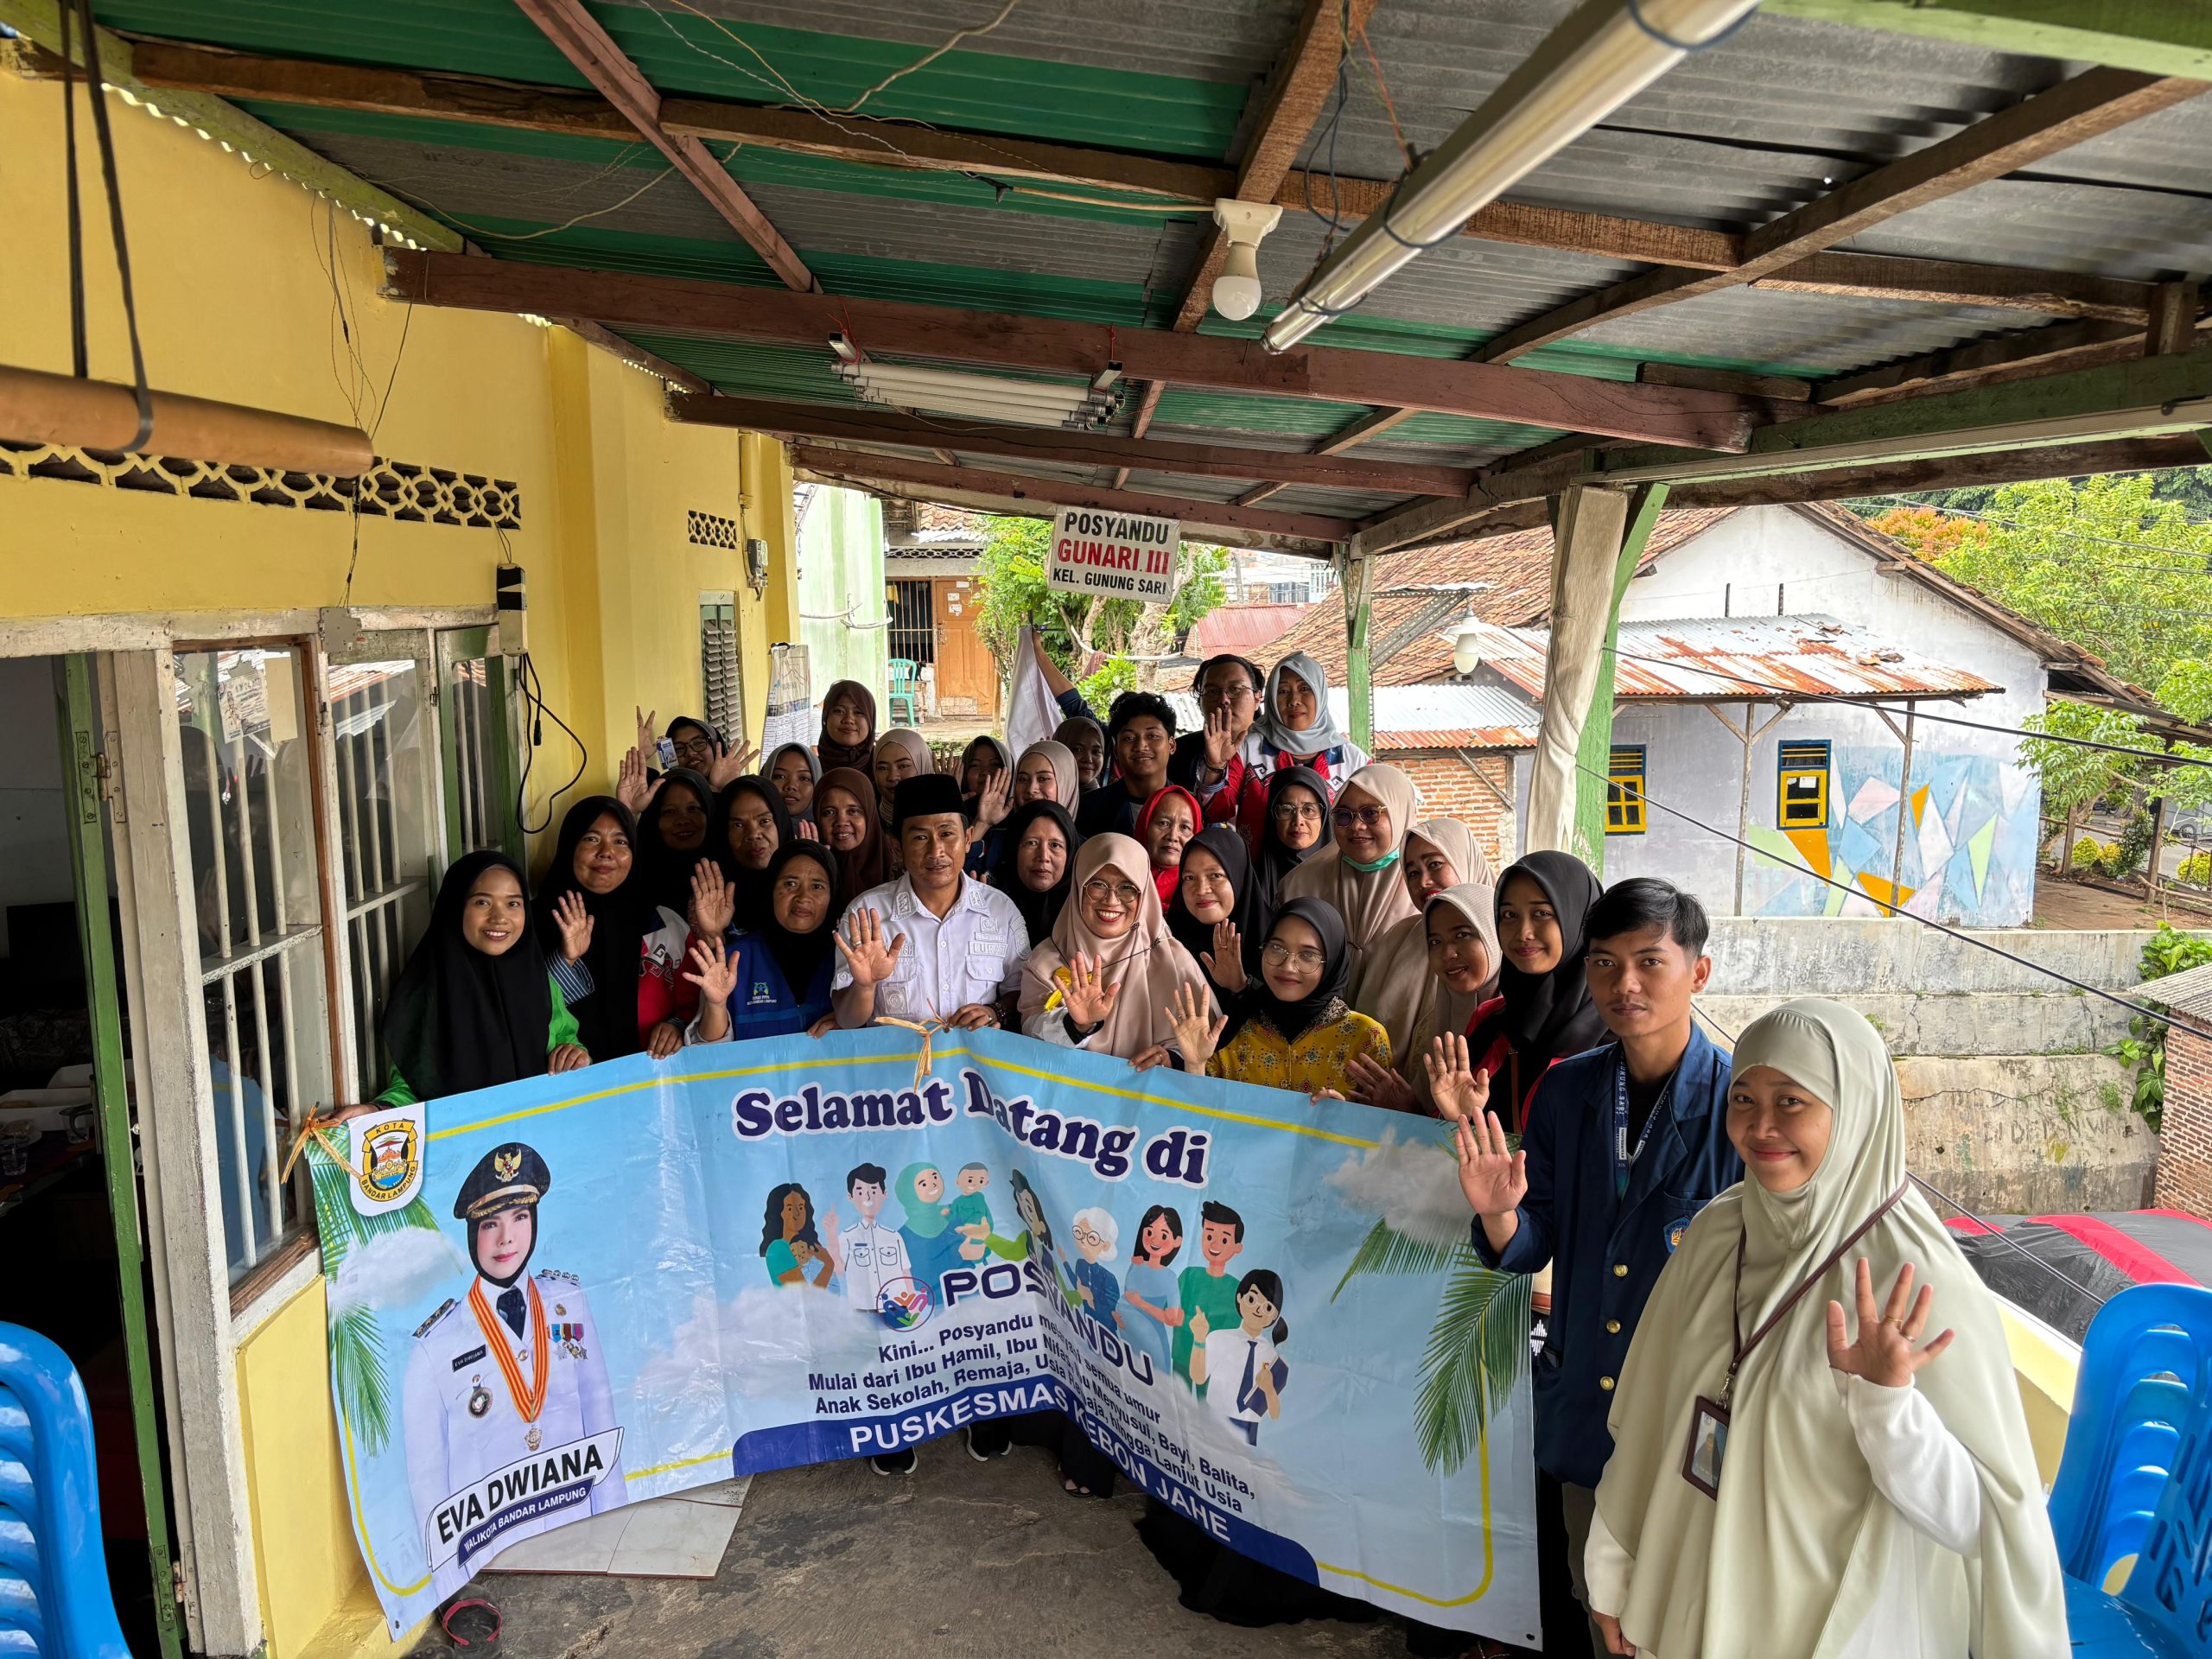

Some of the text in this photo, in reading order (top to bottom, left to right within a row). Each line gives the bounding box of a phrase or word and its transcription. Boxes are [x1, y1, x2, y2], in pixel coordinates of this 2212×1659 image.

[1064, 511, 1169, 545] POSYANDU
[1145, 550, 1170, 575] III
[1052, 567, 1167, 595] KEL. GUNUNG SARI
[375, 1122, 404, 1135] KOTA
[736, 1071, 1208, 1184] Selamat Datang di
[361, 1166, 416, 1199] BANDAR LAMPUNG
[878, 1340, 935, 1363] Kini...
[939, 1314, 1033, 1346] Posyandu
[1084, 1357, 1122, 1399] semua
[1123, 1391, 1161, 1425] umur
[943, 1260, 1154, 1387] POSYANDU
[808, 1373, 857, 1390] Mulai
[862, 1369, 899, 1389] dari
[906, 1361, 937, 1382] Ibu
[941, 1343, 1001, 1370] Hamil,
[1006, 1337, 1037, 1355] Ibu
[1092, 1380, 1156, 1446] Menyusui,
[1159, 1432, 1196, 1471] Bayi,
[1199, 1456, 1256, 1501] Balita,
[815, 1395, 862, 1414] Anak
[868, 1381, 950, 1410] Sekolah,
[954, 1361, 1031, 1386] Remaja,
[1035, 1352, 1066, 1380] Usia
[1109, 1410, 1152, 1458] hingga
[1154, 1448, 1201, 1491] Lanjut
[1205, 1484, 1243, 1514] Usia
[849, 1382, 1231, 1542] PUSKESMAS KEBON JAHE
[436, 1444, 604, 1545] EVA DWIANA
[463, 1486, 587, 1553] WALIKOTA BANDAR LAMPUNG
